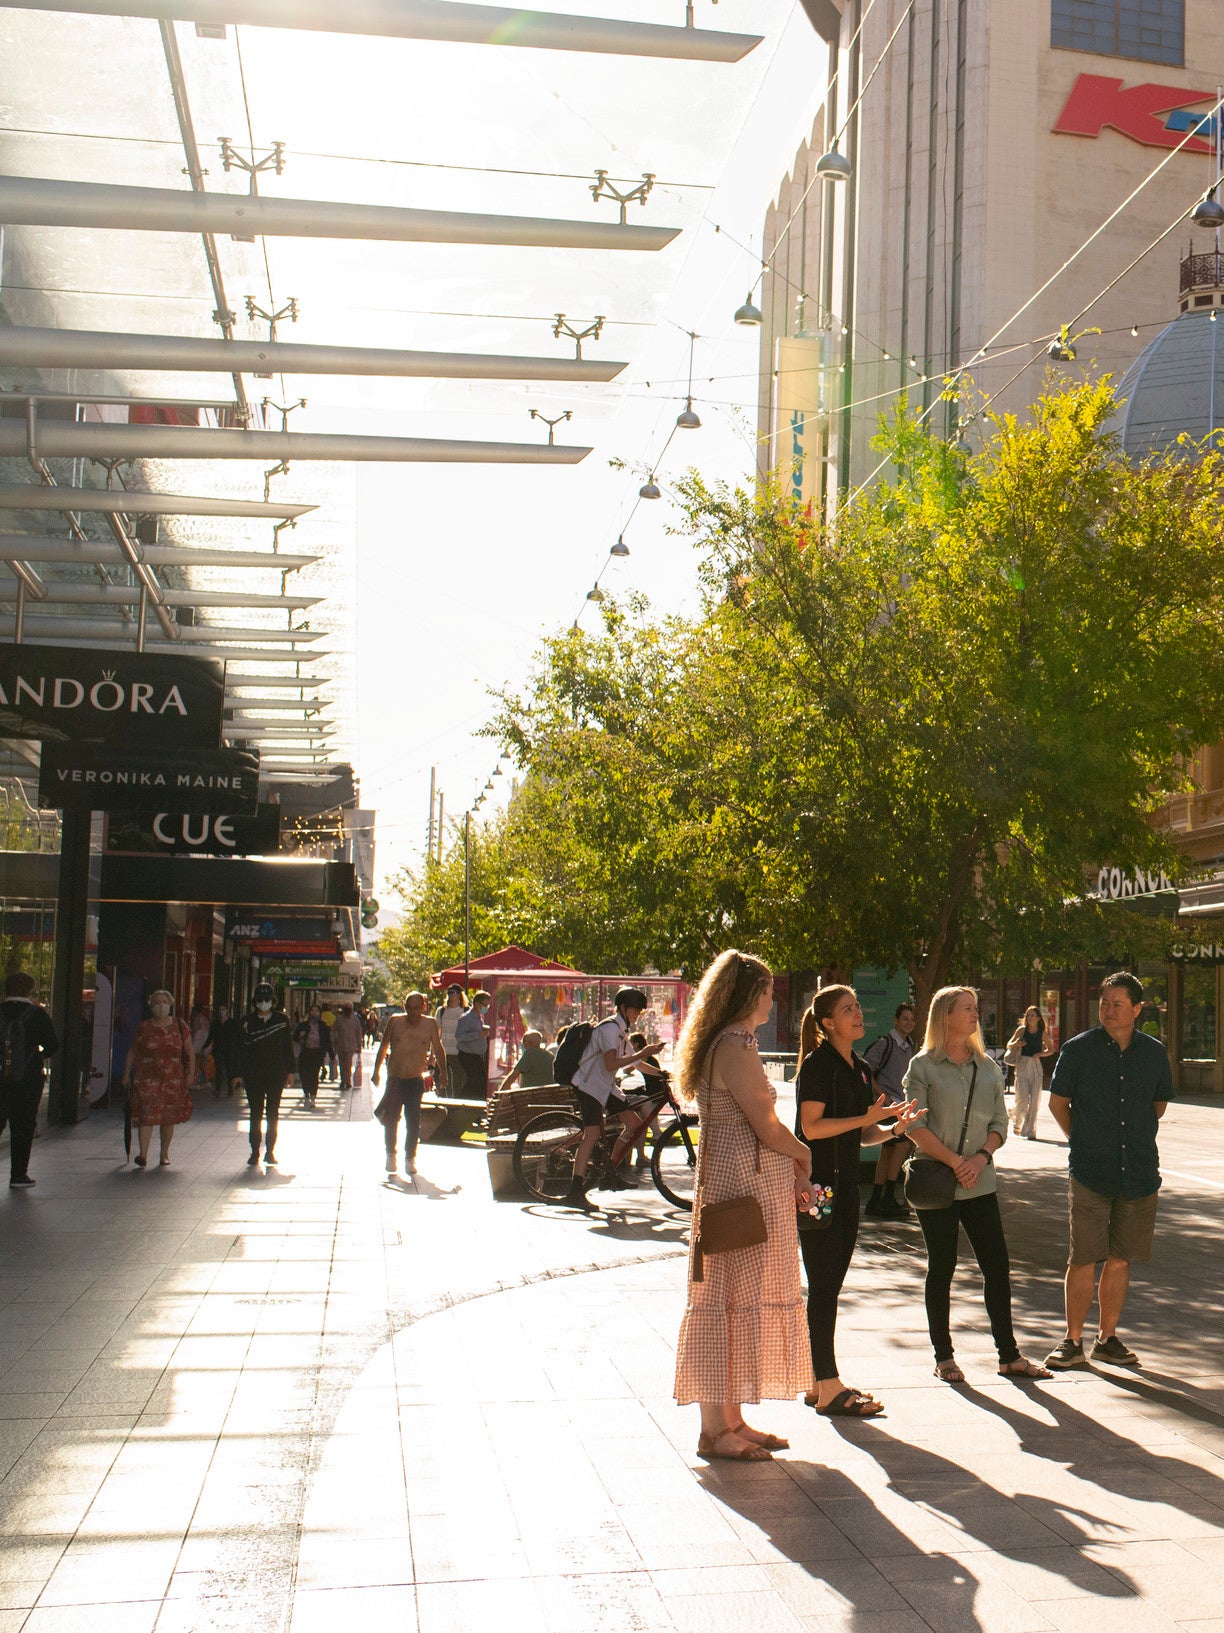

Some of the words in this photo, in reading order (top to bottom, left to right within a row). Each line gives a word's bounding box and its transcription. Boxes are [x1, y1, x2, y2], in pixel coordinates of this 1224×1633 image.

[56, 768, 166, 787] VERONIKA
[177, 774, 244, 791] MAINE
[152, 812, 237, 848] CUE
[230, 925, 261, 937] ANZ
[285, 967, 336, 976] Kathmandu
